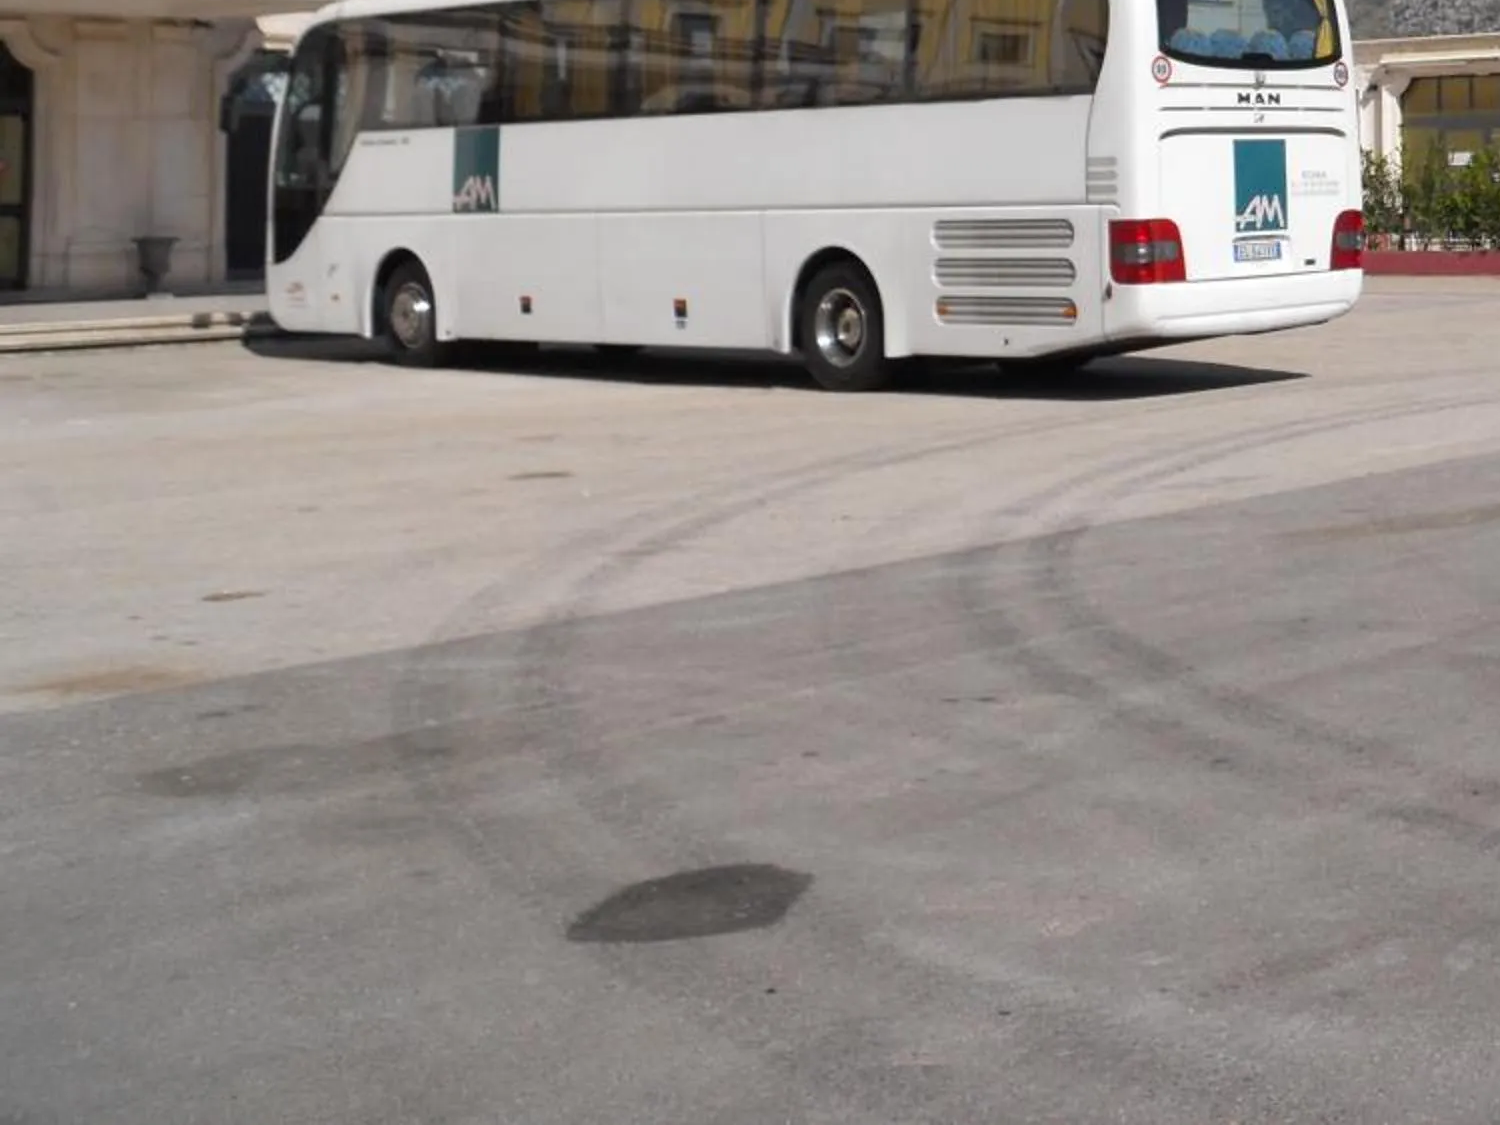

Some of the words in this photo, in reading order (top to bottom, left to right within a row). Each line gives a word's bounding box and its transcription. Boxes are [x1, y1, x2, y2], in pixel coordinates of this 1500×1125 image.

[1237, 92, 1281, 105] MAN
[453, 173, 497, 210] AM
[1235, 194, 1285, 229] AM
